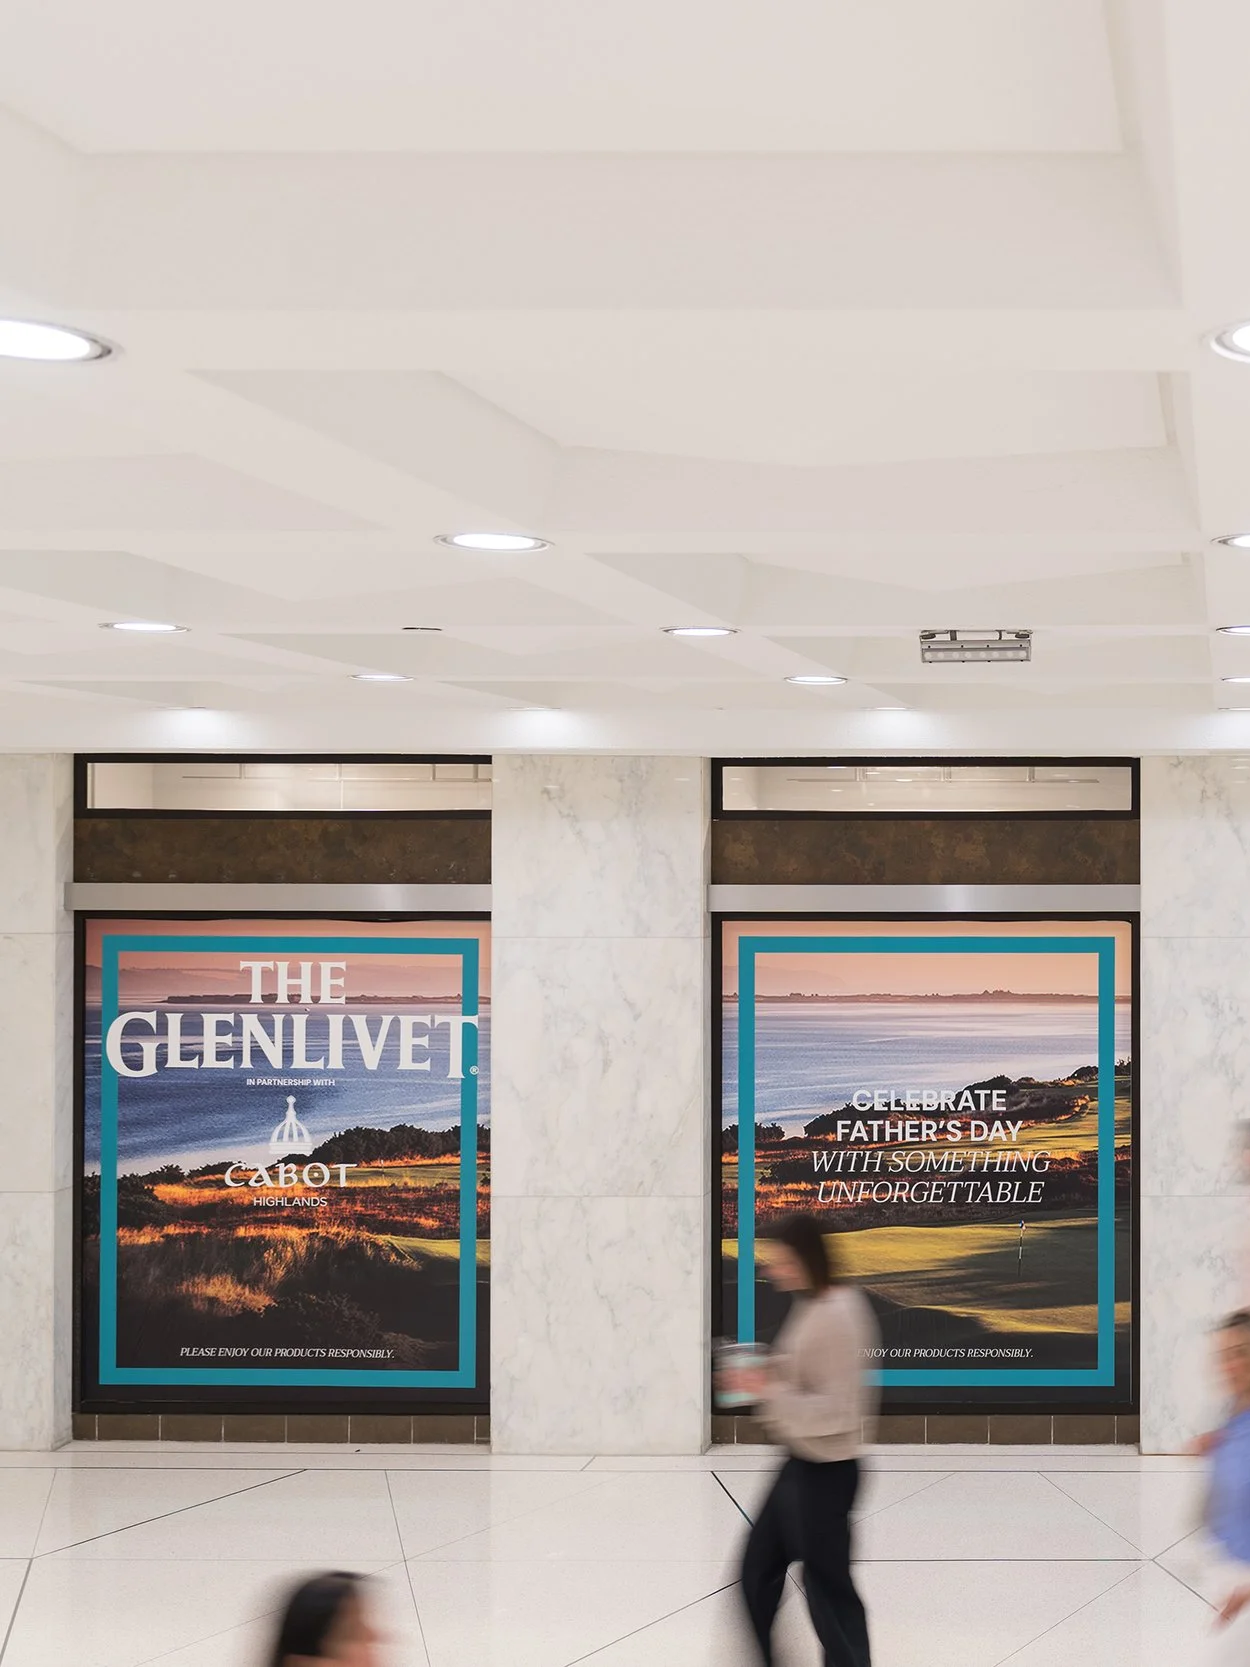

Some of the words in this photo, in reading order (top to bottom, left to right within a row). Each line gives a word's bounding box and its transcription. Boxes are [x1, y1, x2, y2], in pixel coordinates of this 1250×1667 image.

[239, 961, 347, 1005] THE
[246, 1078, 255, 1086] IN
[256, 1078, 312, 1086] PARTNERSHIP
[313, 1078, 336, 1086] WITH
[852, 1089, 1007, 1112] CELEBRATE
[836, 1120, 962, 1142] FATHER'S
[970, 1120, 1023, 1142] DAY
[811, 1150, 884, 1173] WITH
[888, 1150, 1051, 1173] SOMETHING
[224, 1162, 358, 1188] CABOT
[253, 1196, 328, 1207] HIGHLANDS
[817, 1181, 1045, 1203] UNFORGETTABLE
[180, 1347, 217, 1357] PLEASE
[218, 1347, 250, 1358] ENJOY
[250, 1347, 273, 1357] OUR
[274, 1348, 327, 1358] PRODUCTS
[328, 1348, 395, 1359] RESPONSIBLY.
[890, 1348, 911, 1358] OUR
[913, 1348, 965, 1358] PRODUCTS
[967, 1348, 1034, 1358] RESPONSIBLY.
